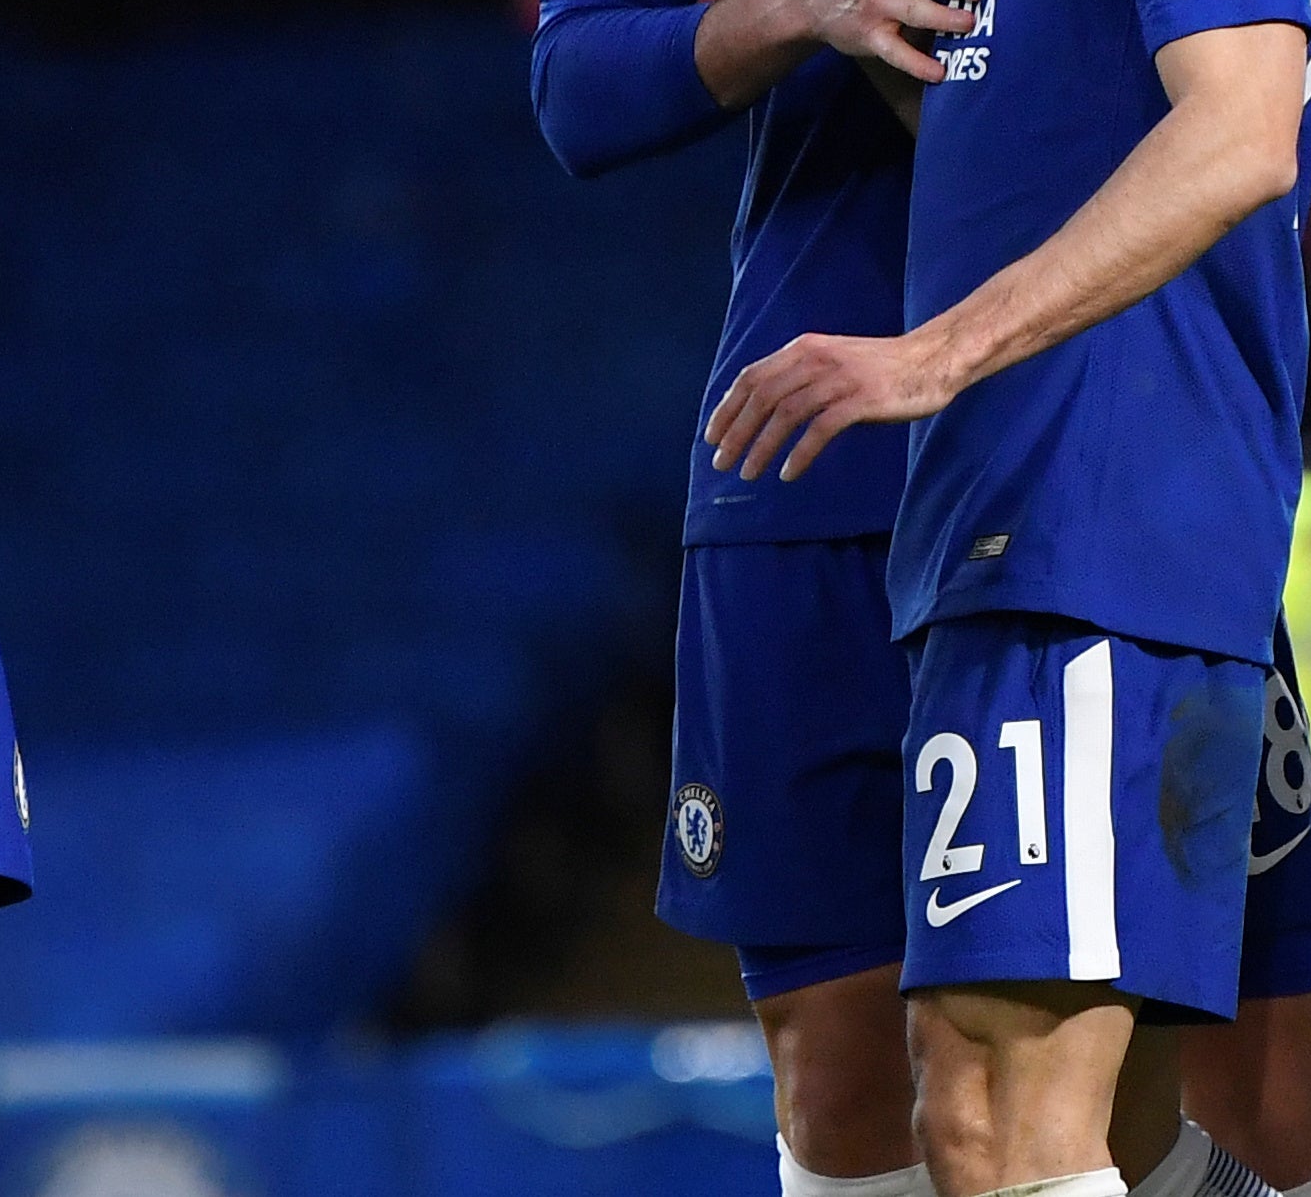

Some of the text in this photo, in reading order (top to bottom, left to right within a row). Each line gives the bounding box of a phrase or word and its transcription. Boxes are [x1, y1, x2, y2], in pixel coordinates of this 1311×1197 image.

[935, 46, 991, 82] TYRES
[678, 787, 716, 813] CHELSEA
[915, 719, 1048, 882] 21
